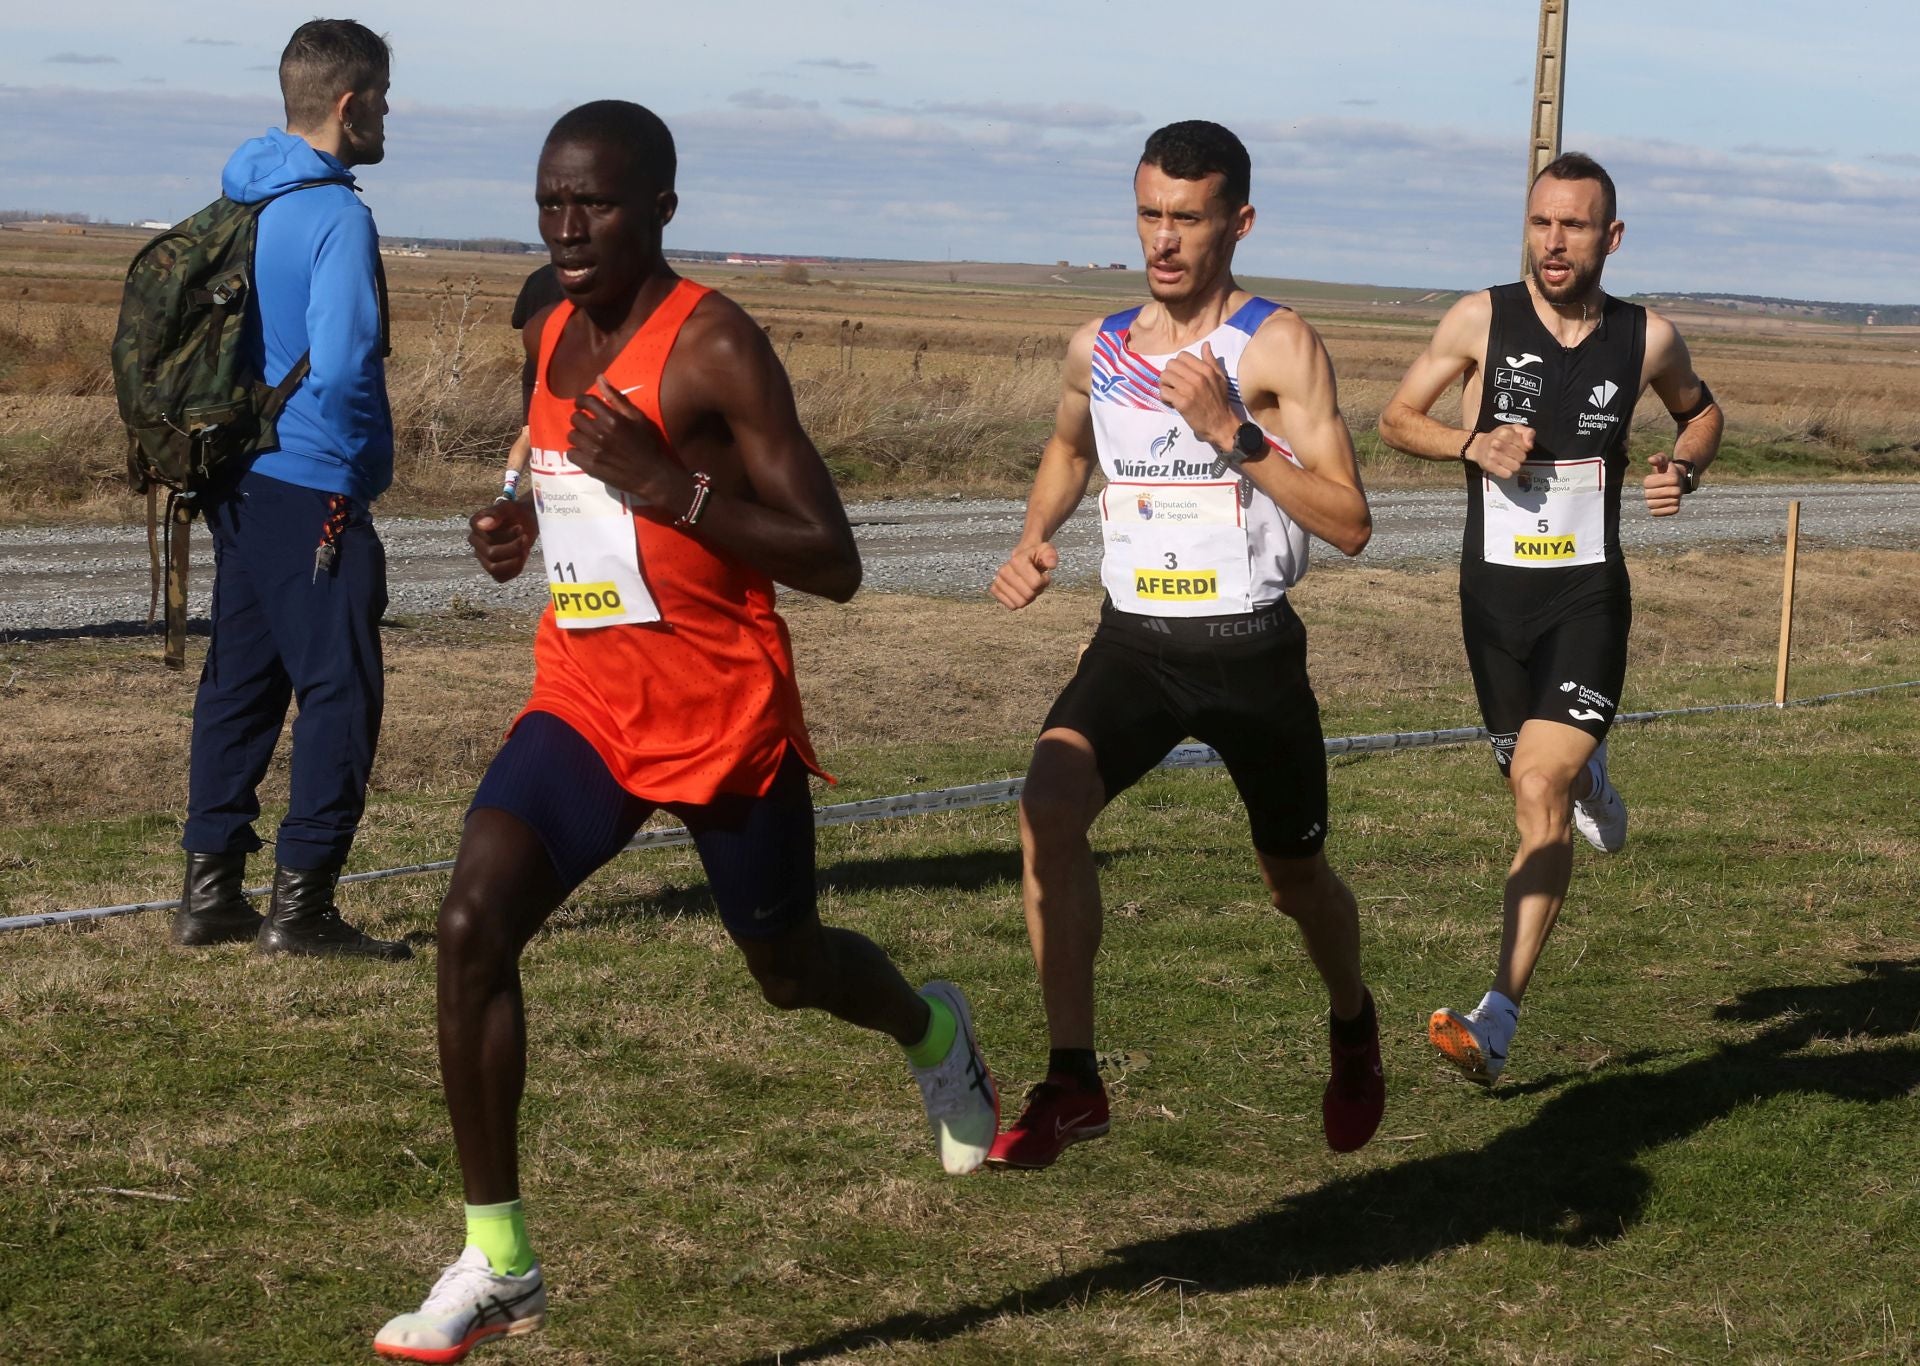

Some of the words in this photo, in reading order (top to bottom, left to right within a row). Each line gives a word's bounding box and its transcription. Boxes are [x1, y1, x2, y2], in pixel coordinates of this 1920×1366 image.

[1580, 412, 1619, 423] Fundación
[1578, 420, 1608, 431] Unicaja
[1533, 476, 1570, 484] Diputación
[1544, 485, 1570, 493] Segovia
[1155, 500, 1197, 510] Diputación
[1167, 511, 1199, 521] Segovia
[1537, 519, 1549, 533] 5
[1514, 540, 1575, 555] KNIYA
[1163, 552, 1178, 570] 3
[553, 562, 578, 583] 11
[1136, 576, 1217, 595] AFERDI
[1579, 684, 1614, 709] Fundación
